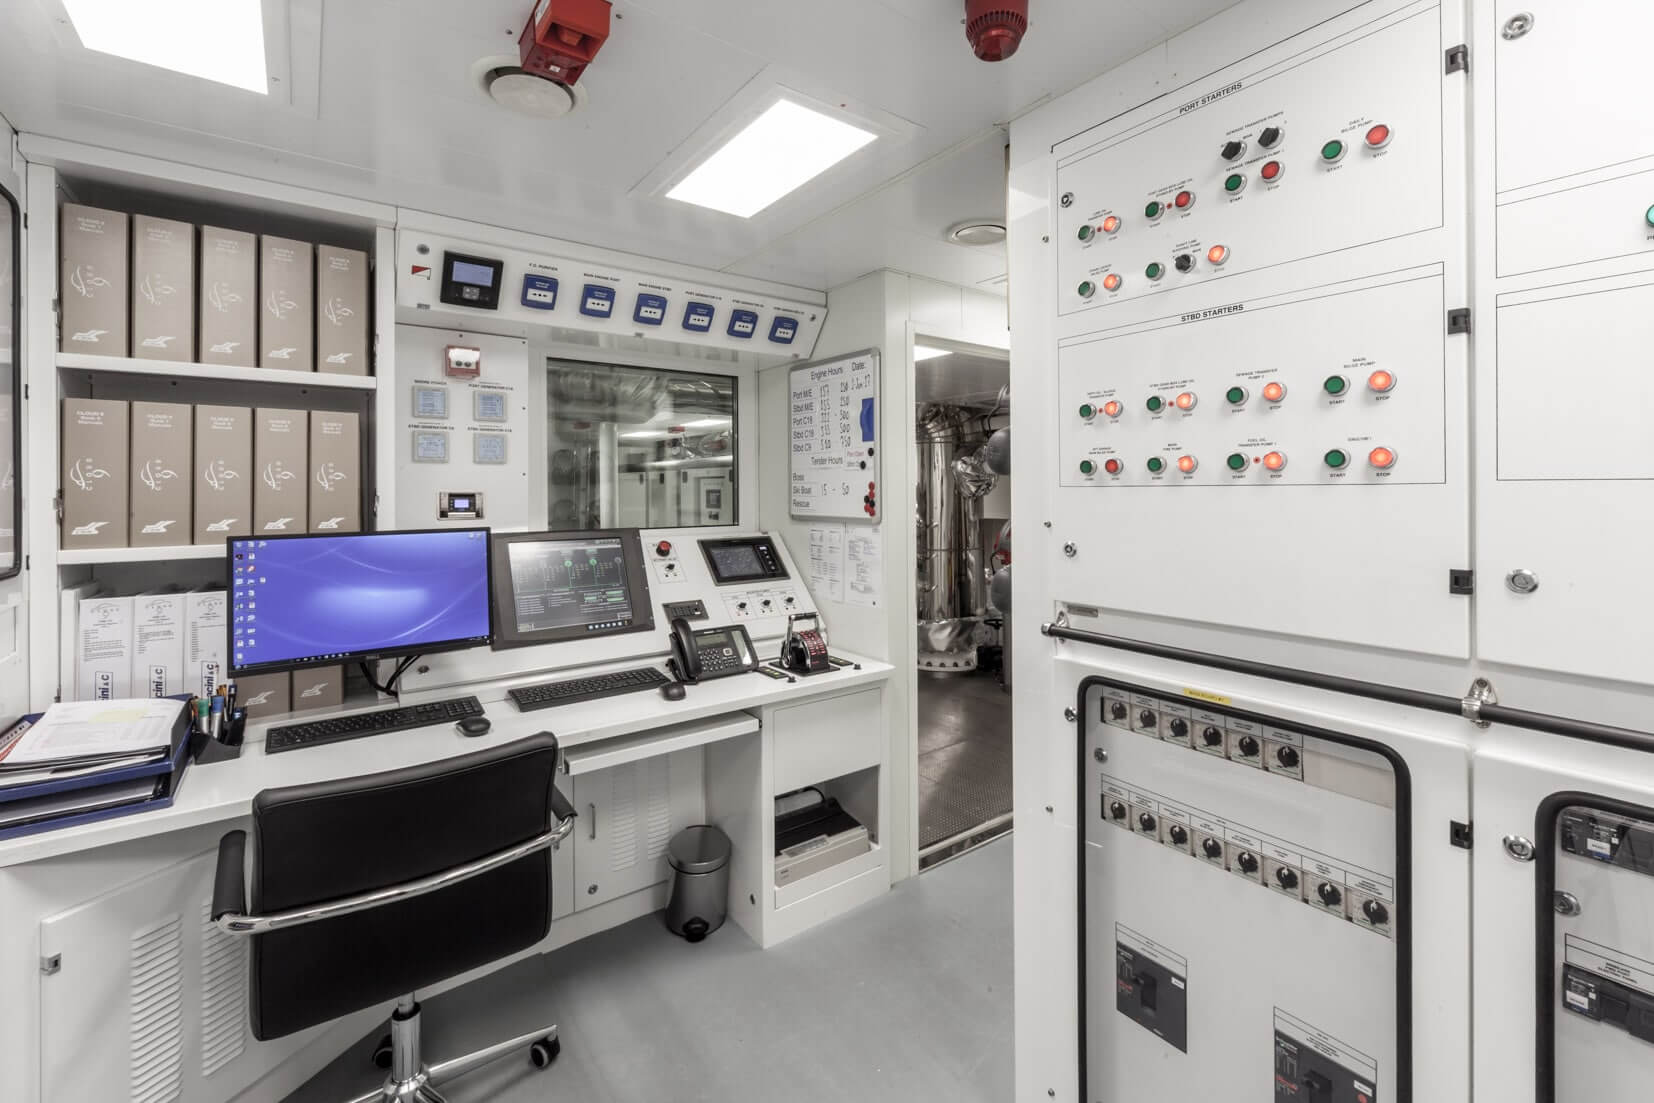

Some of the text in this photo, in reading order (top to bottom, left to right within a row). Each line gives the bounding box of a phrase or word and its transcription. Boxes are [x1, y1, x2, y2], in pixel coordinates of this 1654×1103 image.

[1179, 82, 1243, 114] PORT STARTERS
[1372, 151, 1389, 159] STOP
[1326, 165, 1344, 173] START
[1181, 304, 1245, 322] STBD STARTERS
[810, 366, 844, 381] Engine Hours
[792, 391, 803, 400] Port
[792, 403, 804, 413] Stbd
[792, 417, 803, 426] Port
[792, 430, 804, 439] Stbd
[792, 443, 804, 452] Stbd
[810, 456, 827, 466] Tender
[827, 456, 843, 466] Hours
